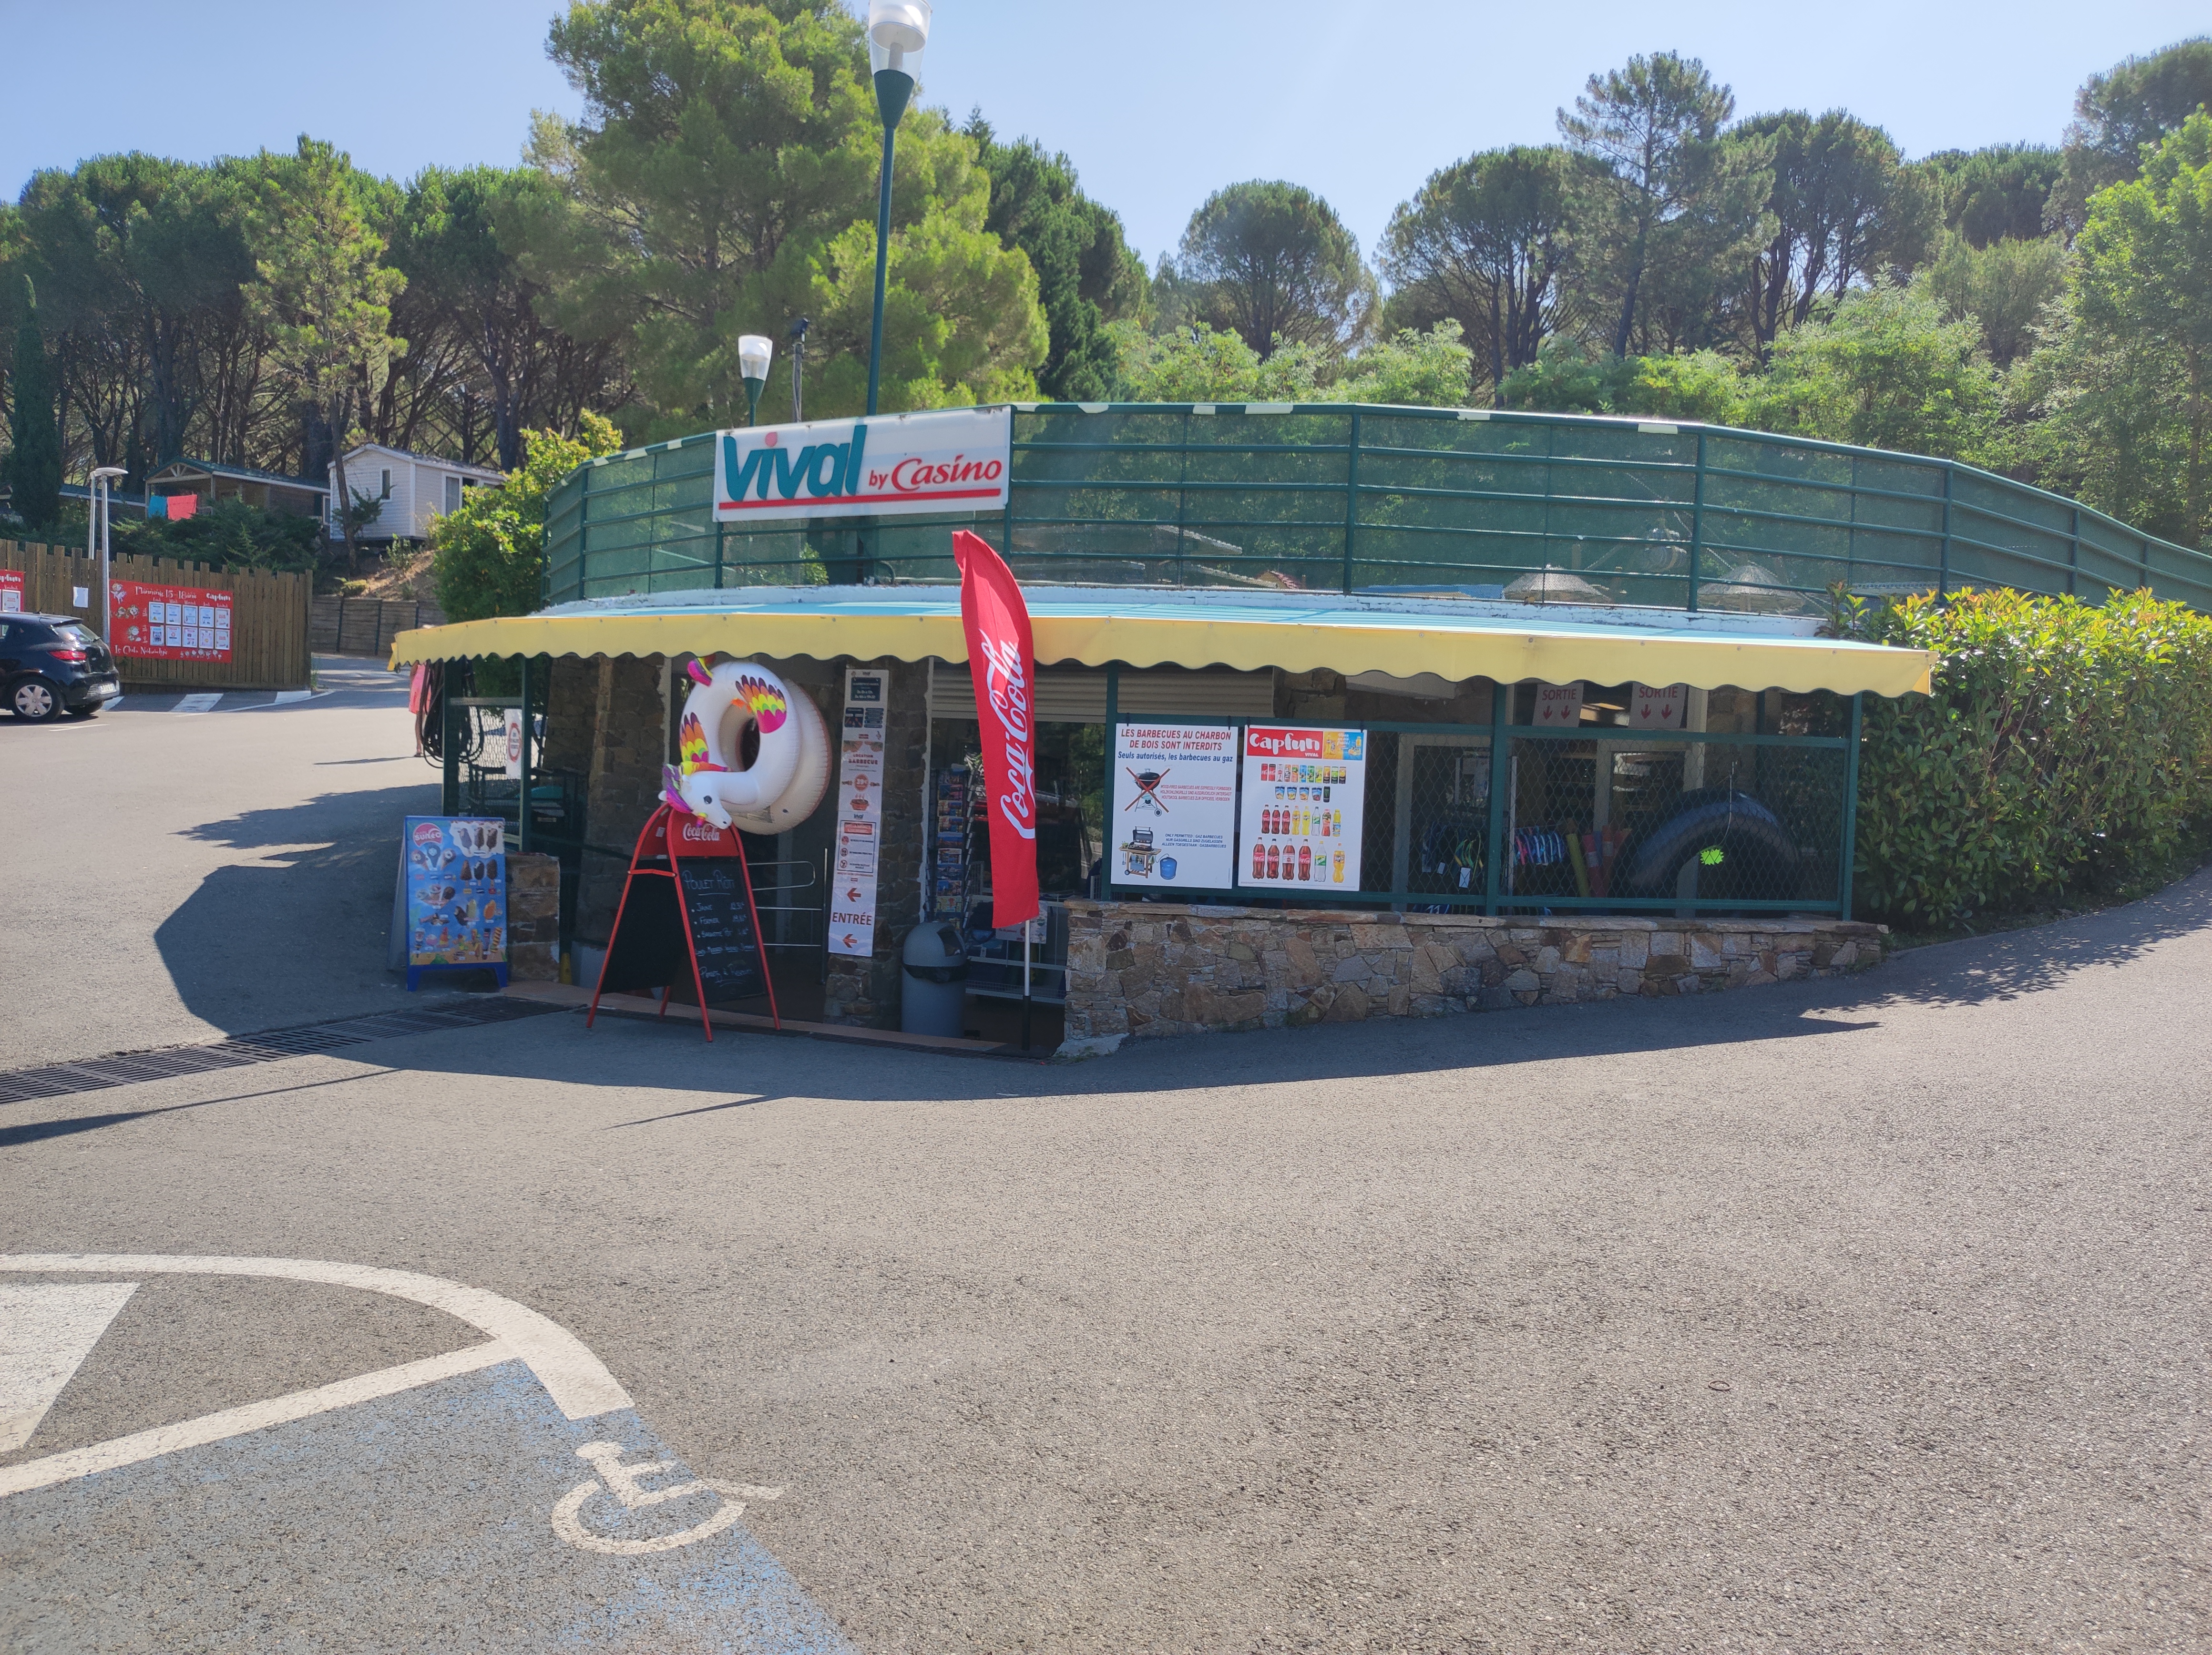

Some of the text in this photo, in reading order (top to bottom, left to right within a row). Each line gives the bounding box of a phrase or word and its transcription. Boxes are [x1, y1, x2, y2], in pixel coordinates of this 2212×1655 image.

[869, 470, 889, 490] by
[891, 454, 1002, 492] Casino
[1542, 688, 1577, 700] SORTIE
[1121, 729, 1231, 740] LES BARBECUES AU CHARBON
[1129, 740, 1222, 751] DE BOIS SONT INTERDITS
[1137, 752, 1167, 762] autorisés,
[1179, 753, 1211, 762] barbecues
[832, 912, 872, 926] ENTRÉE
